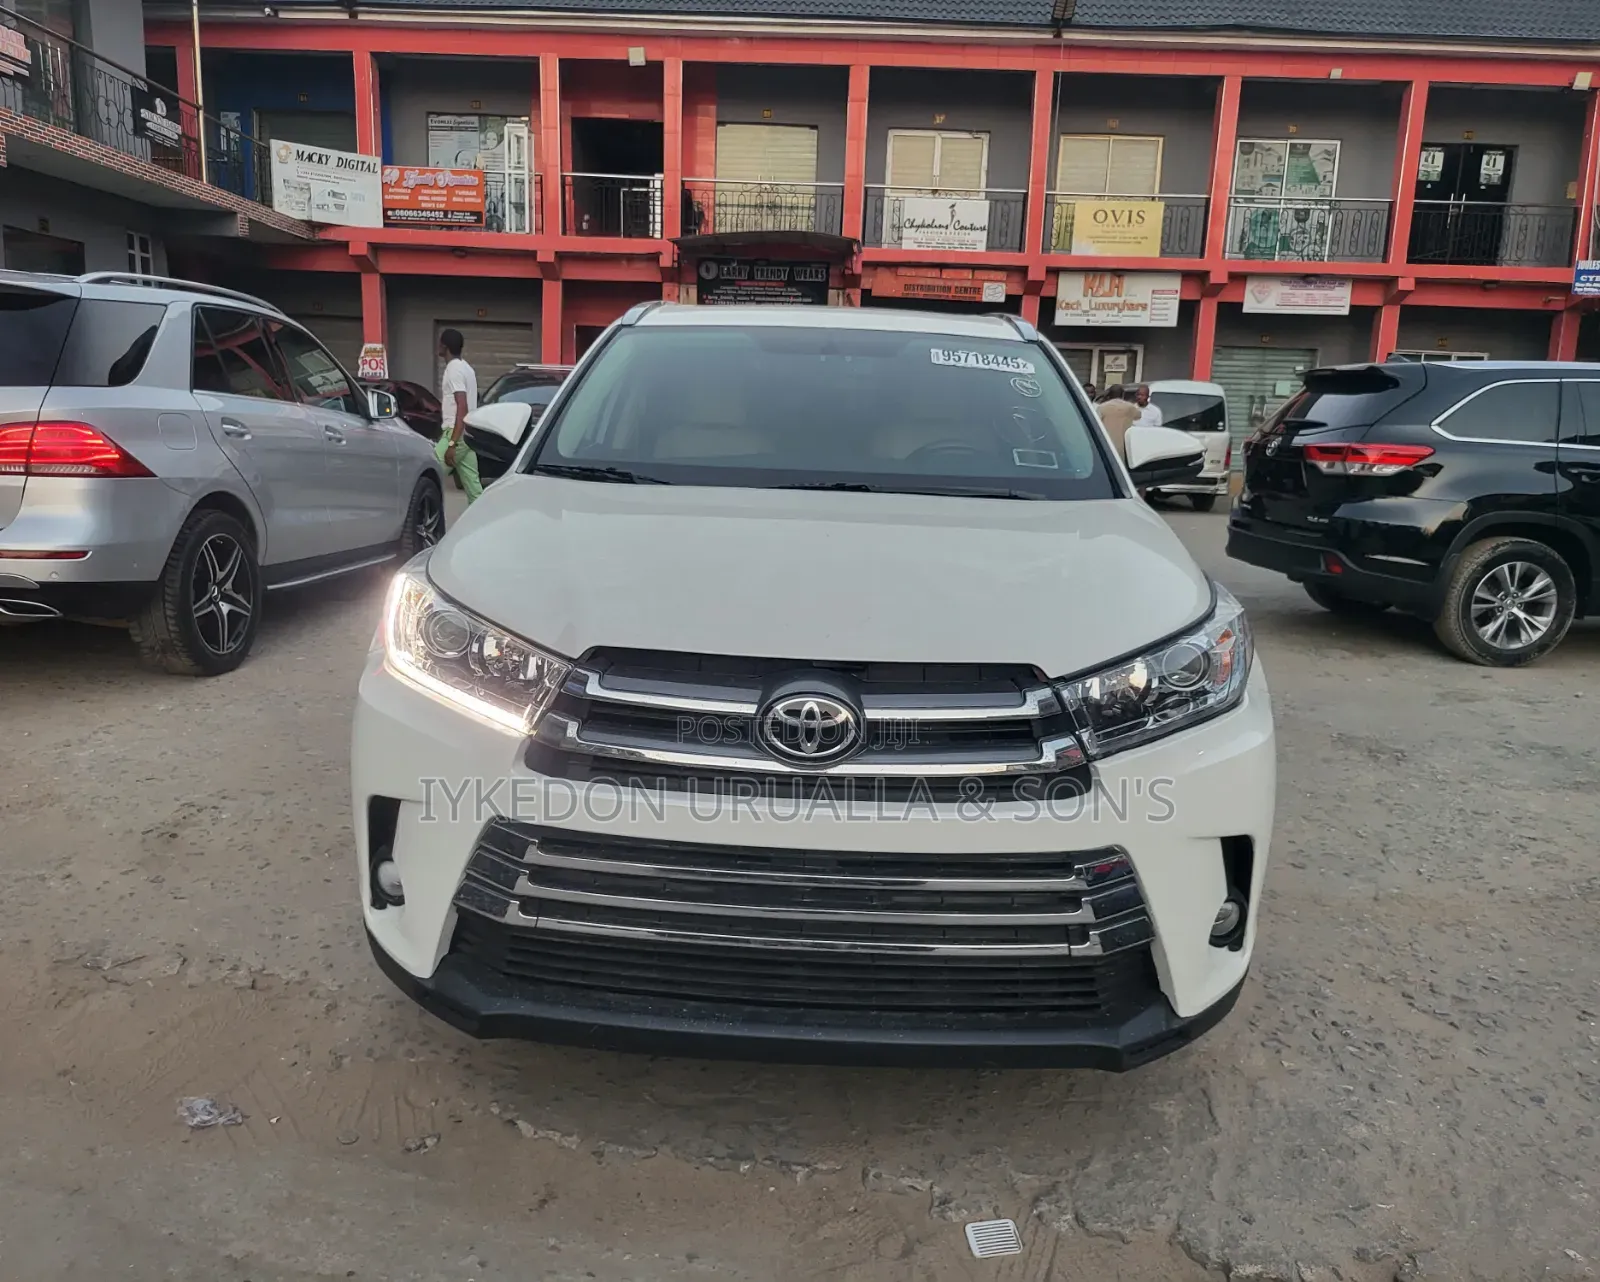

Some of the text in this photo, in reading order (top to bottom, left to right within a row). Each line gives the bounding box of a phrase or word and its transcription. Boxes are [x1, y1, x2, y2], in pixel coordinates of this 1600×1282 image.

[295, 149, 332, 166] MACKY
[336, 156, 379, 174] DIGITAL
[1093, 209, 1146, 225] OVIS
[753, 266, 789, 281] TRENDY
[793, 266, 827, 282] WEARS
[954, 286, 982, 294] CENTRE
[361, 358, 384, 371] POS
